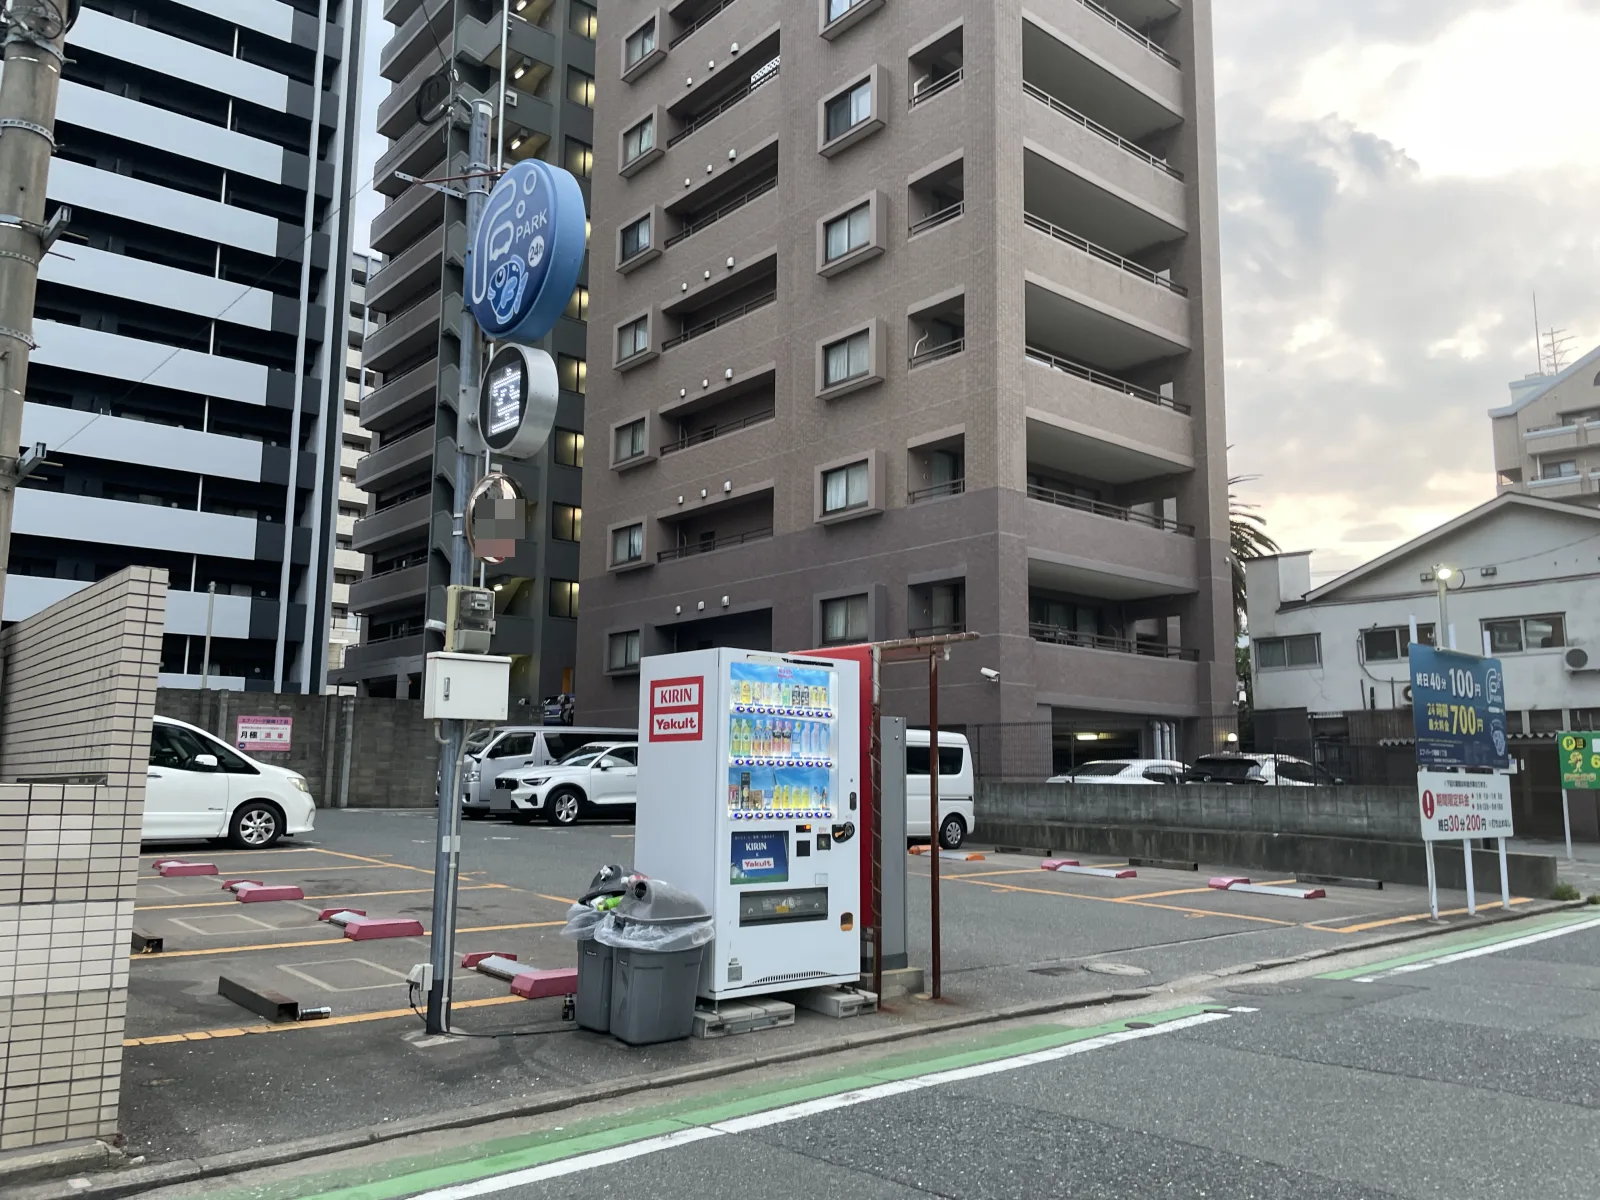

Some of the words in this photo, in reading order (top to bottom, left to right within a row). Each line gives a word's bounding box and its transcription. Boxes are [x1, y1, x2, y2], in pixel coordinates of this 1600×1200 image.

[516, 208, 548, 245] PARK
[529, 243, 544, 261] 24h
[491, 367, 521, 434] 空
[660, 687, 692, 704] KIRIN
[656, 717, 696, 731] Yakult
[1429, 719, 1450, 732] 最大料金
[1450, 704, 1484, 735] 700円
[240, 731, 258, 739] 月極
[1436, 793, 1469, 807] 期間限定料金
[745, 842, 767, 851] KIRIN
[744, 860, 772, 868] Yakult
